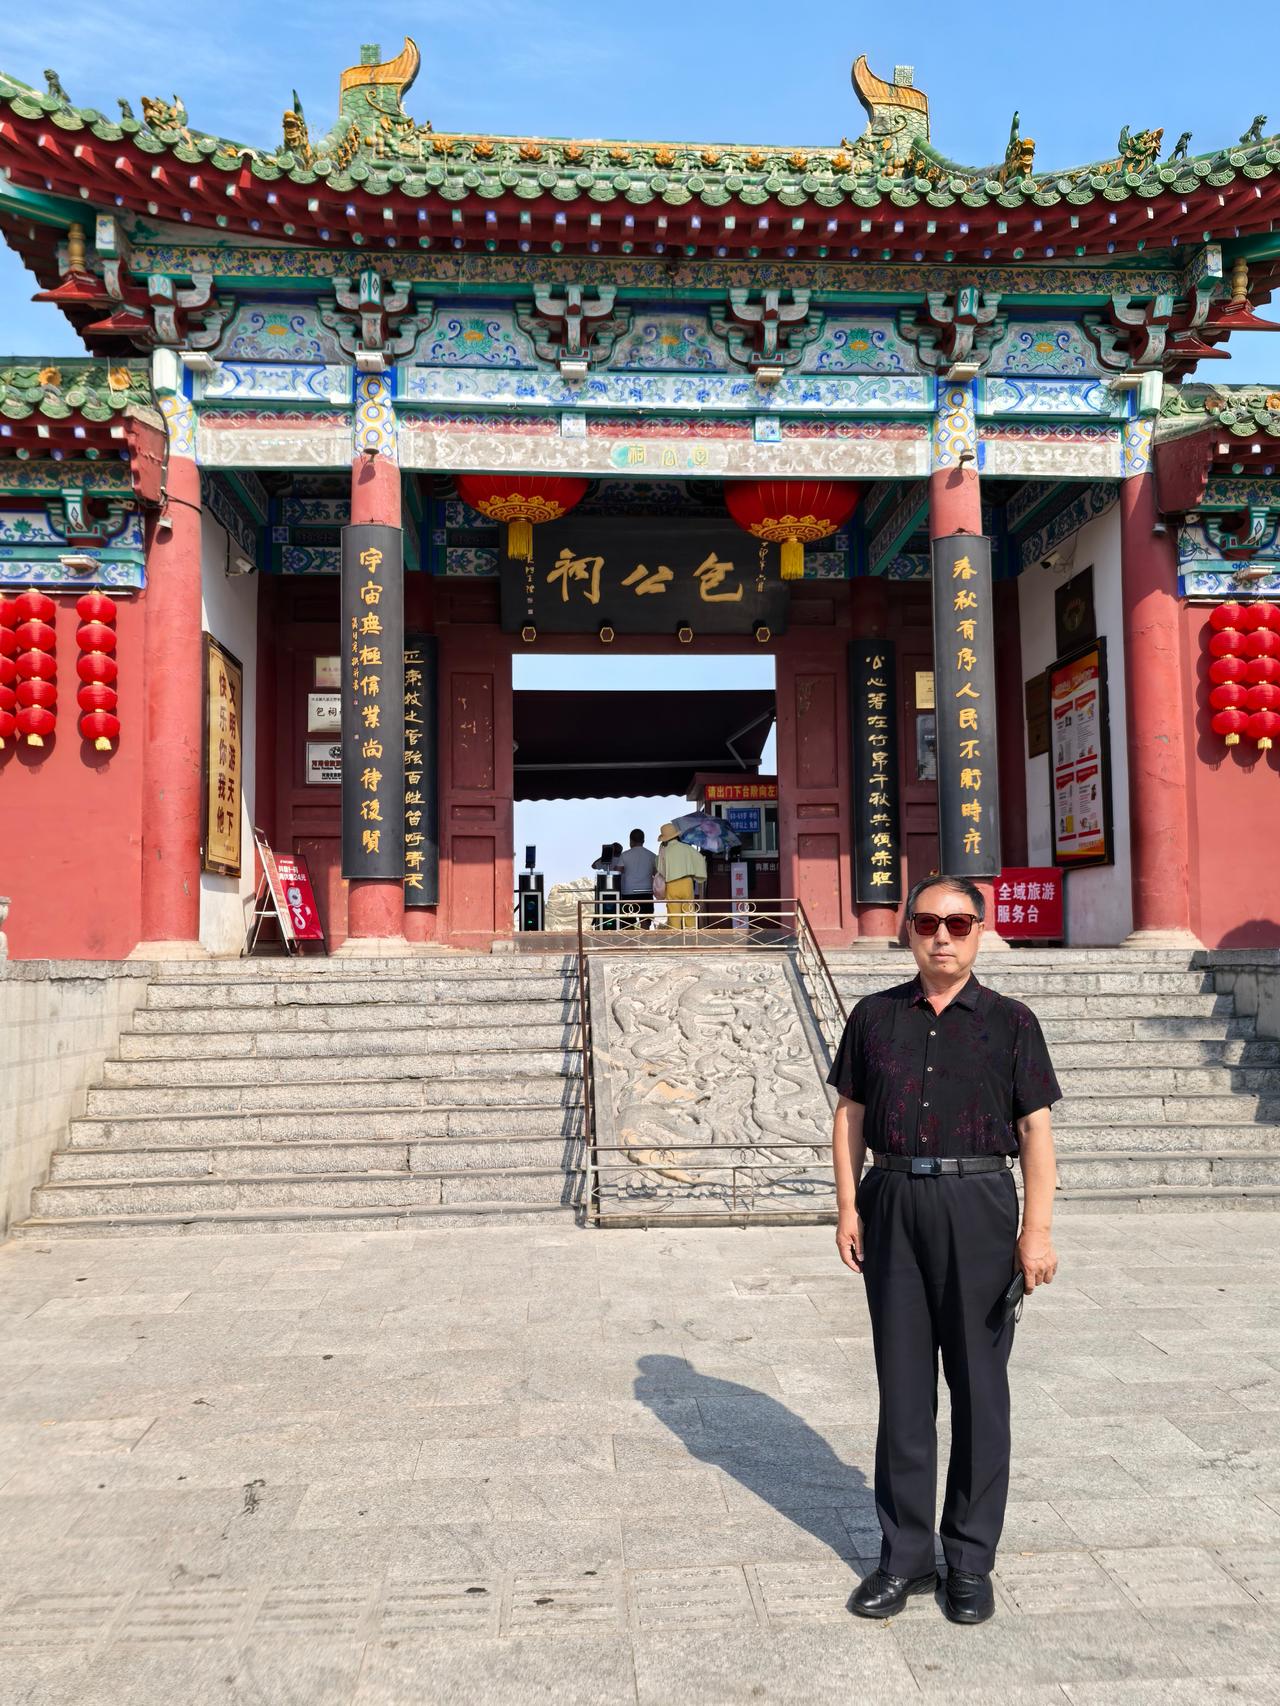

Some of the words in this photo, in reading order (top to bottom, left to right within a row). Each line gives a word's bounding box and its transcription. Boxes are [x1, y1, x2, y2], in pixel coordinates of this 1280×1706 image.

[546, 547, 743, 605] 包公祠
[217, 670, 228, 834] 快乐你我他
[226, 680, 236, 837] 文明游天下
[707, 785, 777, 799] 请出门下台阶向左
[998, 881, 1055, 900] 全域旅游
[997, 904, 1039, 923] 服务台
